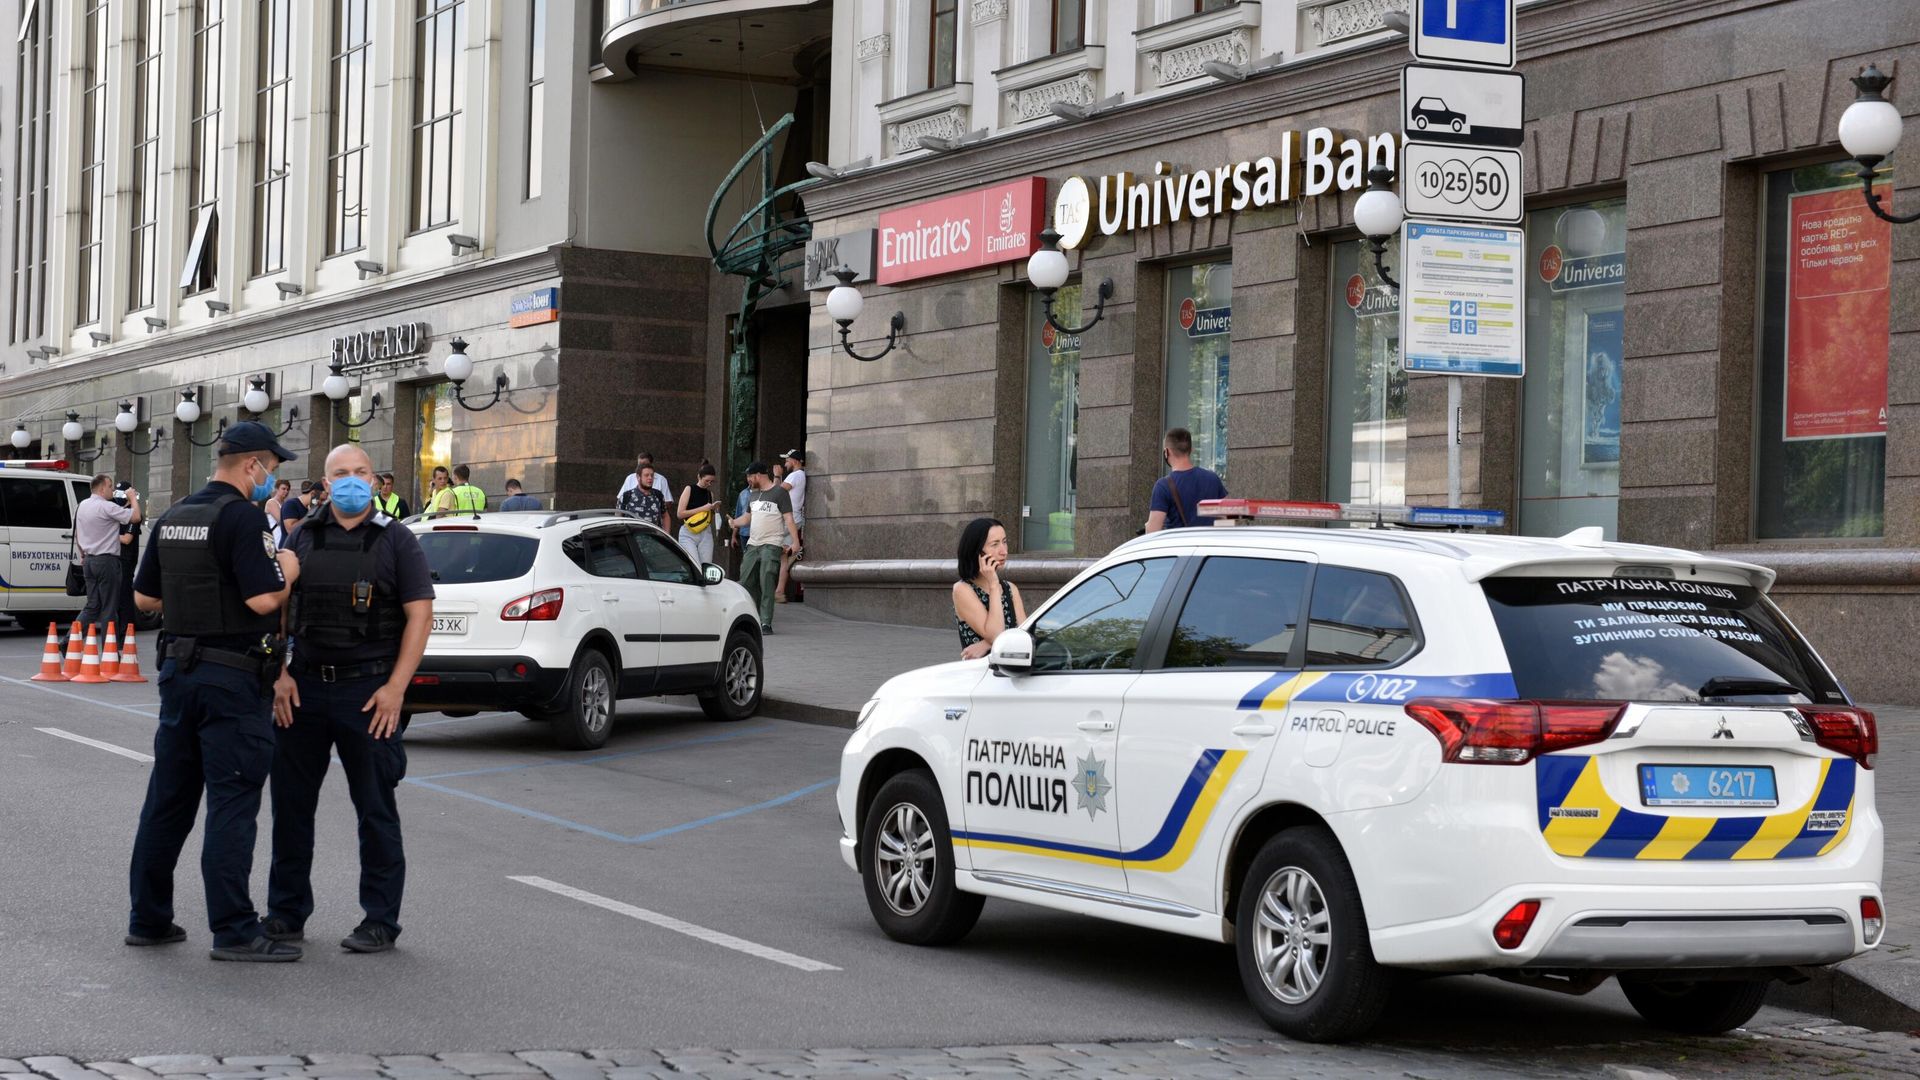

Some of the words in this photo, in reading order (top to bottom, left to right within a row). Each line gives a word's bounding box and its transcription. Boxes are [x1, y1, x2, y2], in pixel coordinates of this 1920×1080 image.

[1100, 130, 1291, 236] Universal
[1305, 127, 1396, 198] Ban
[1421, 171, 1439, 189] 10
[1445, 171, 1467, 192] 25
[1475, 171, 1502, 197] 50
[1801, 219, 1822, 230] Нова
[1823, 215, 1862, 229] кредитна
[882, 218, 971, 268] Emirates
[987, 231, 1026, 254] Emirates
[1801, 233, 1828, 244] картка
[1830, 228, 1848, 239] RED
[1800, 243, 1842, 256] особлива,
[1843, 242, 1853, 251] як
[1854, 241, 1859, 252] у
[1800, 258, 1828, 269] Тільки
[1828, 254, 1864, 266] червона
[331, 321, 418, 366] BROCARD
[160, 525, 209, 541] ПОЛІЦІЯ
[30, 562, 61, 571] СЛУЖБА
[1556, 579, 1669, 594] ПАТРУЛЬНА
[1669, 581, 1737, 600] ПОЛІЦІЯ
[1602, 602, 1627, 613] МИ
[1628, 601, 1707, 612] ПРАЦЮЄМО
[1574, 619, 1596, 629] ТИ
[1598, 615, 1698, 627] ЗАЛИШАЄШСЯ
[1701, 616, 1747, 629] ВДОМА
[1573, 629, 1656, 645] ЗУПИНИМО
[1658, 628, 1718, 639] COVID-19
[1720, 631, 1764, 644] РАЗОМ
[1371, 678, 1417, 701] 102
[1290, 716, 1343, 733] PATROL
[1345, 718, 1396, 737] POLICE
[967, 738, 1067, 770] ПАТРУЛЬНА
[966, 770, 1068, 814] ПОЛІЦІЯ
[1708, 770, 1756, 798] 6217
